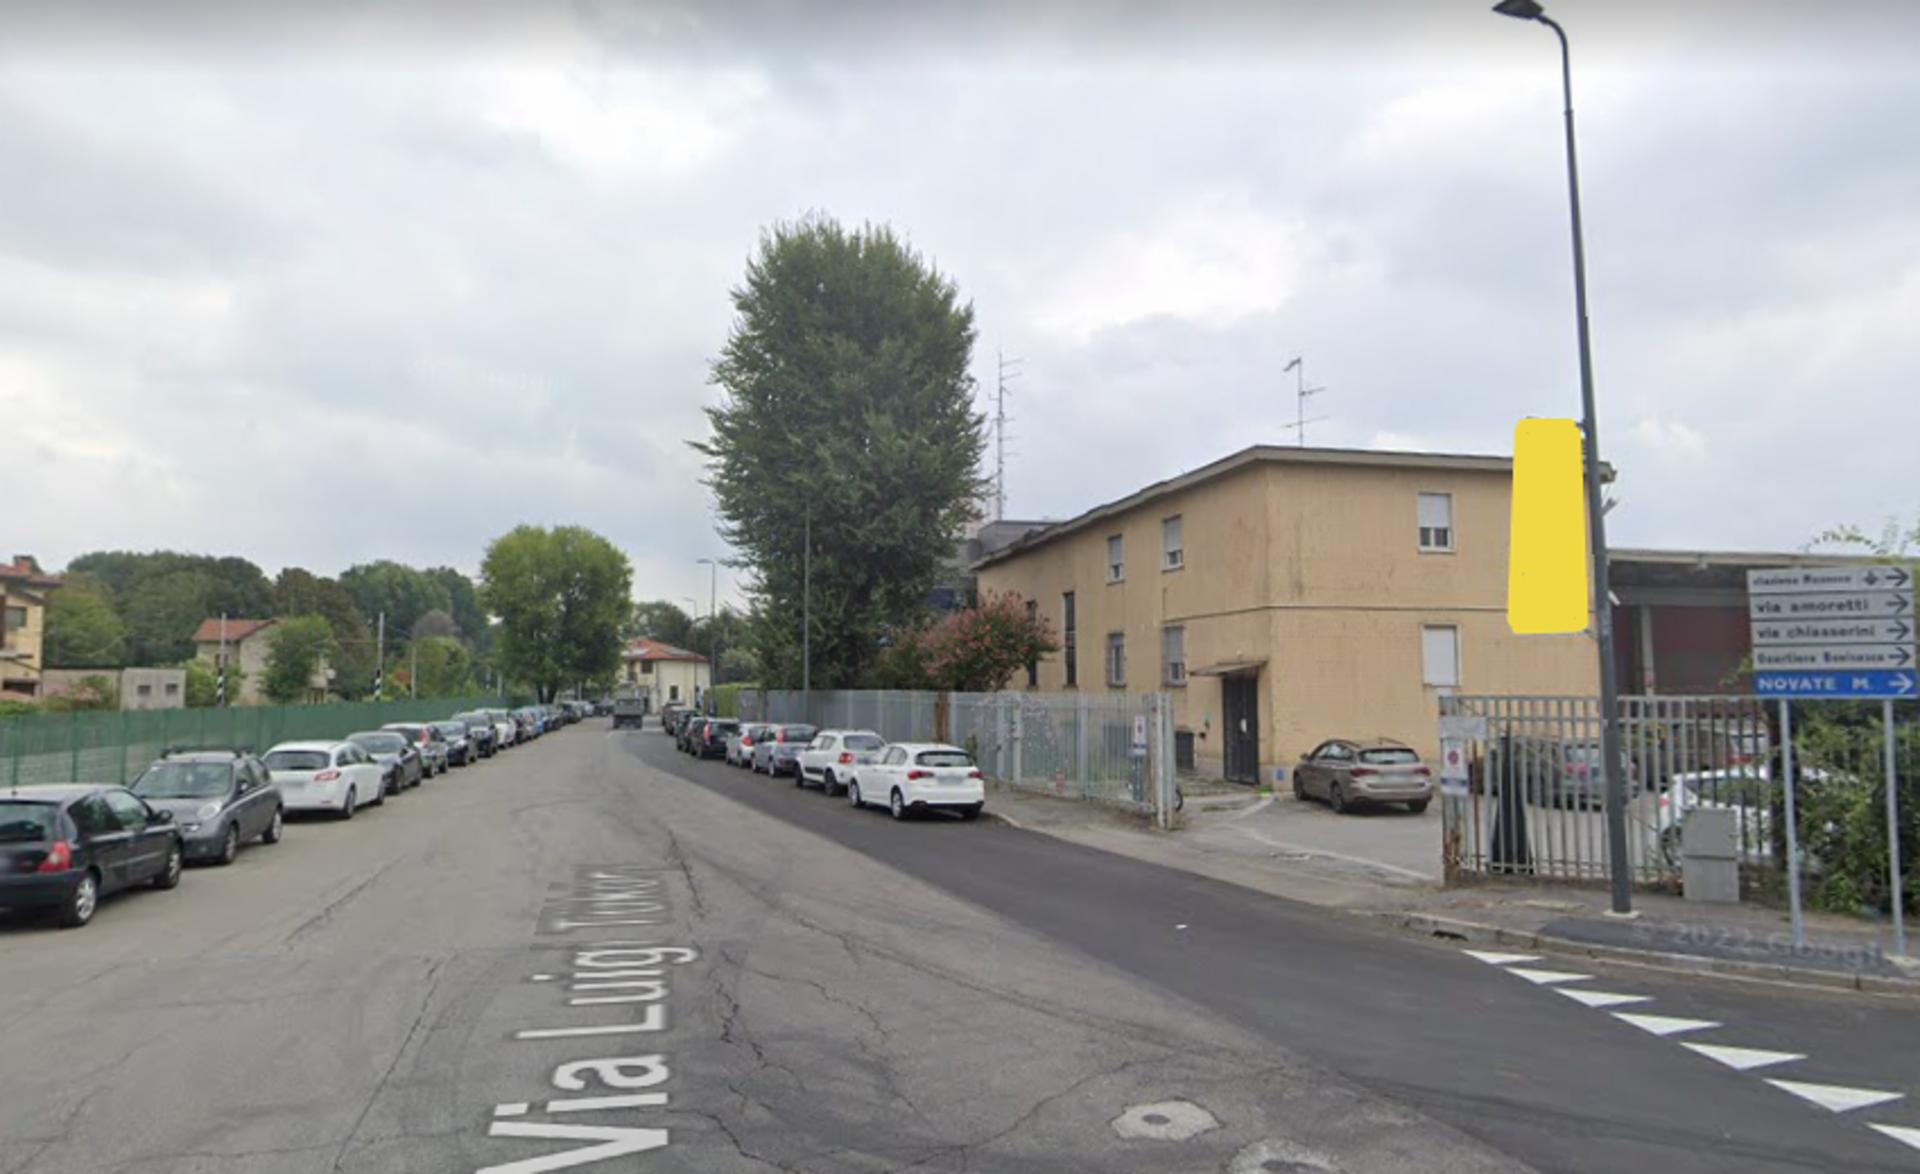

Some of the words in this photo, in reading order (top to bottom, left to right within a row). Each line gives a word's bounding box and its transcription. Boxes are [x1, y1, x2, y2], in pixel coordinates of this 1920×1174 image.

[1756, 600, 1781, 613] via
[1790, 598, 1870, 613] amoretti
[1757, 626, 1780, 639] via
[1757, 676, 1838, 691] NOVATE
